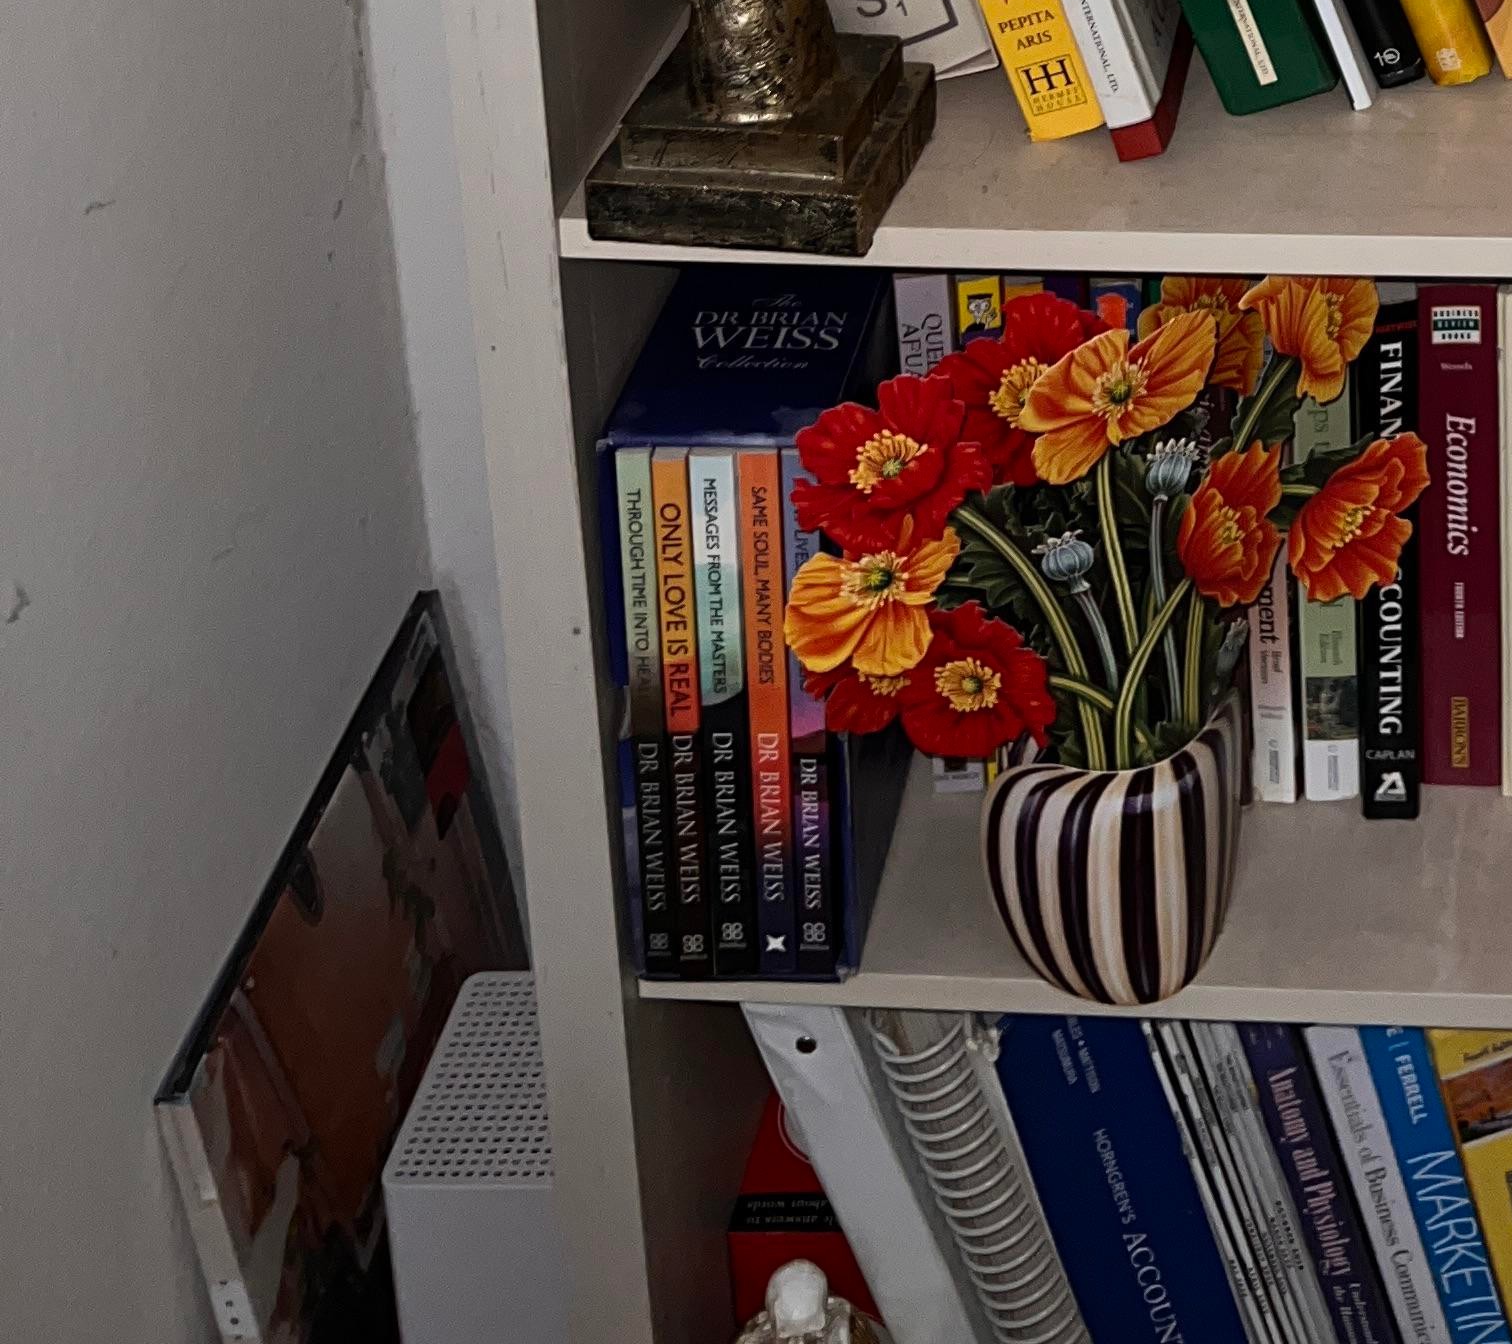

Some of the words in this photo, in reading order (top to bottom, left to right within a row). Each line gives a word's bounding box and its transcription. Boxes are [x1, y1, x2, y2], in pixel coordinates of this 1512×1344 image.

[998, 8, 1055, 36] PEPITA
[1015, 31, 1054, 51] ARIS
[1444, 412, 1479, 558] Economics
[659, 502, 684, 565] ONLY
[663, 570, 688, 634] LOVE
[666, 640, 688, 660] IS
[668, 664, 694, 716] REAL
[1394, 1053, 1428, 1126] FERRELL
